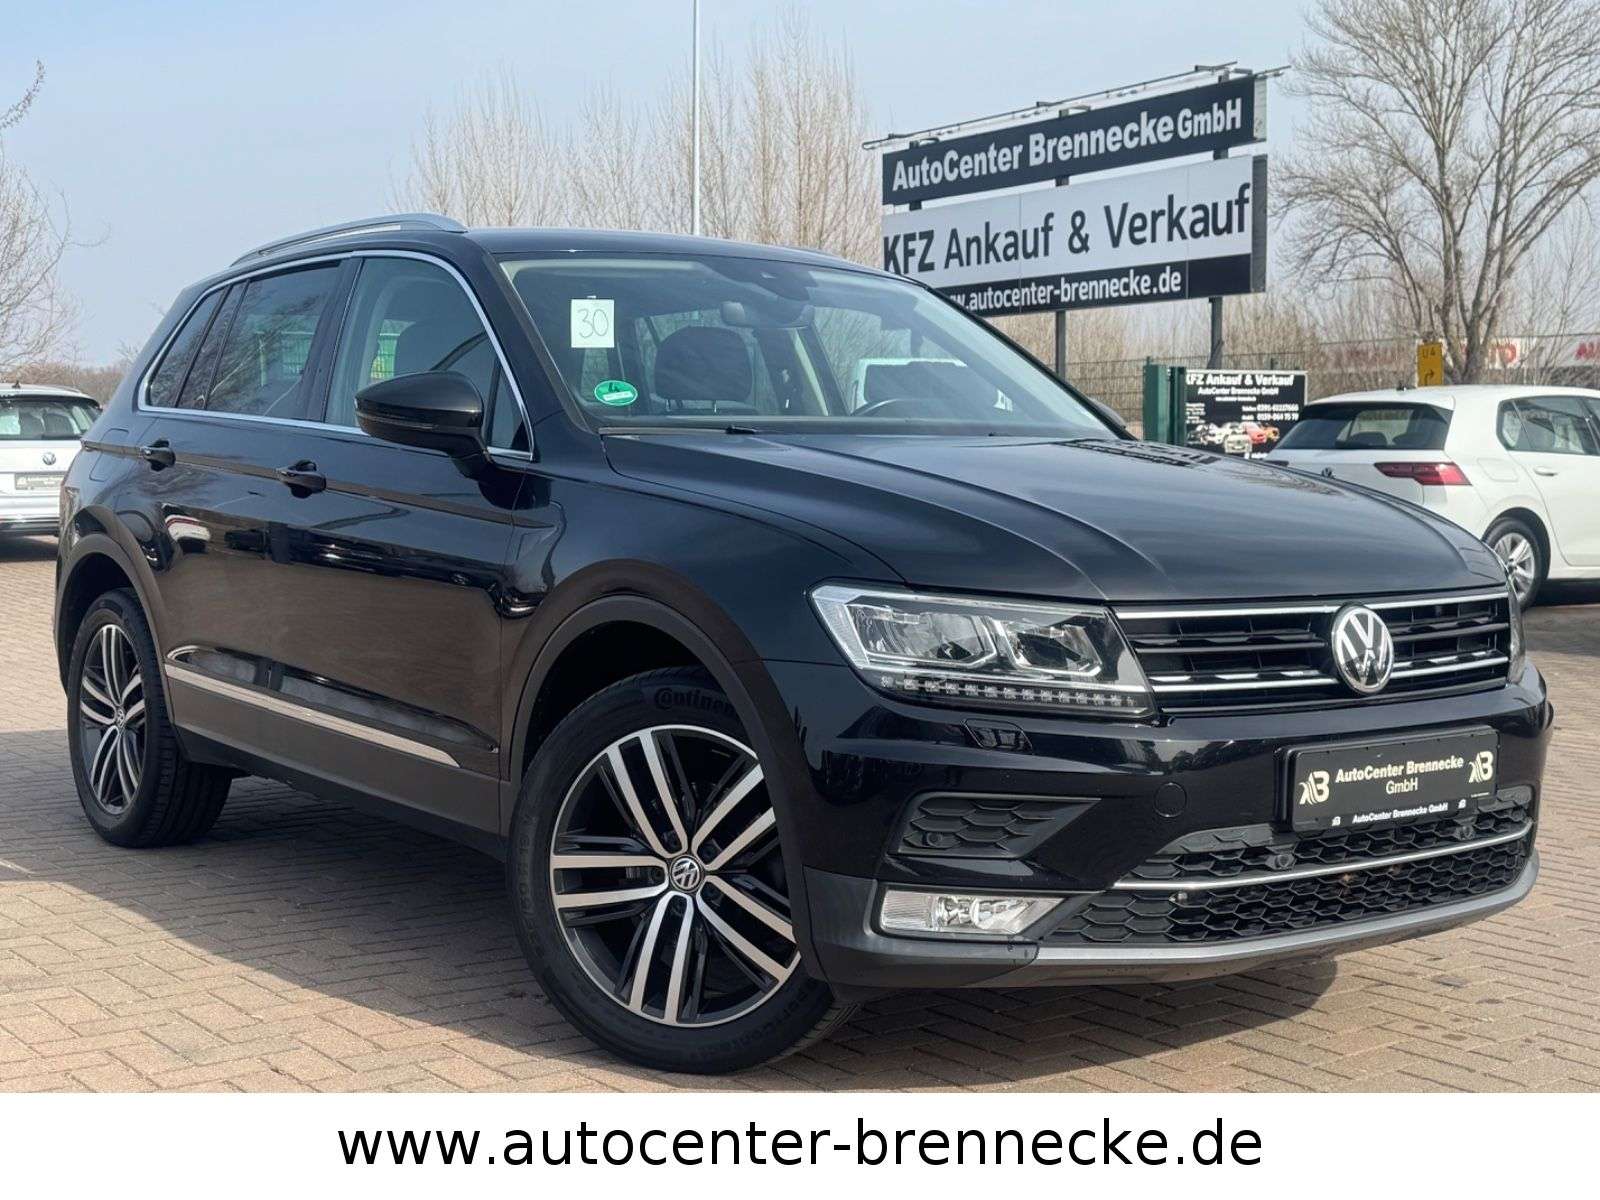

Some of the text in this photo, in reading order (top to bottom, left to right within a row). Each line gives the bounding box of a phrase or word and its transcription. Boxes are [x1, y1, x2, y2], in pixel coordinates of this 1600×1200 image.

[892, 98, 1242, 192] AutoCenter Brennecke GmbH
[883, 183, 1250, 275] KFZ Ankauf & Verkauf
[950, 265, 1182, 312] w.autocenter-brennecke.de
[577, 308, 609, 339] 30
[1206, 374, 1242, 385] Ankauf
[1244, 374, 1253, 385] &
[1255, 374, 1294, 386] Verkauf
[1335, 755, 1464, 784] AutoCenter Brennecke
[1386, 778, 1418, 795] GmbH
[1352, 802, 1449, 825] AutoCenter Brennecke GmbH
